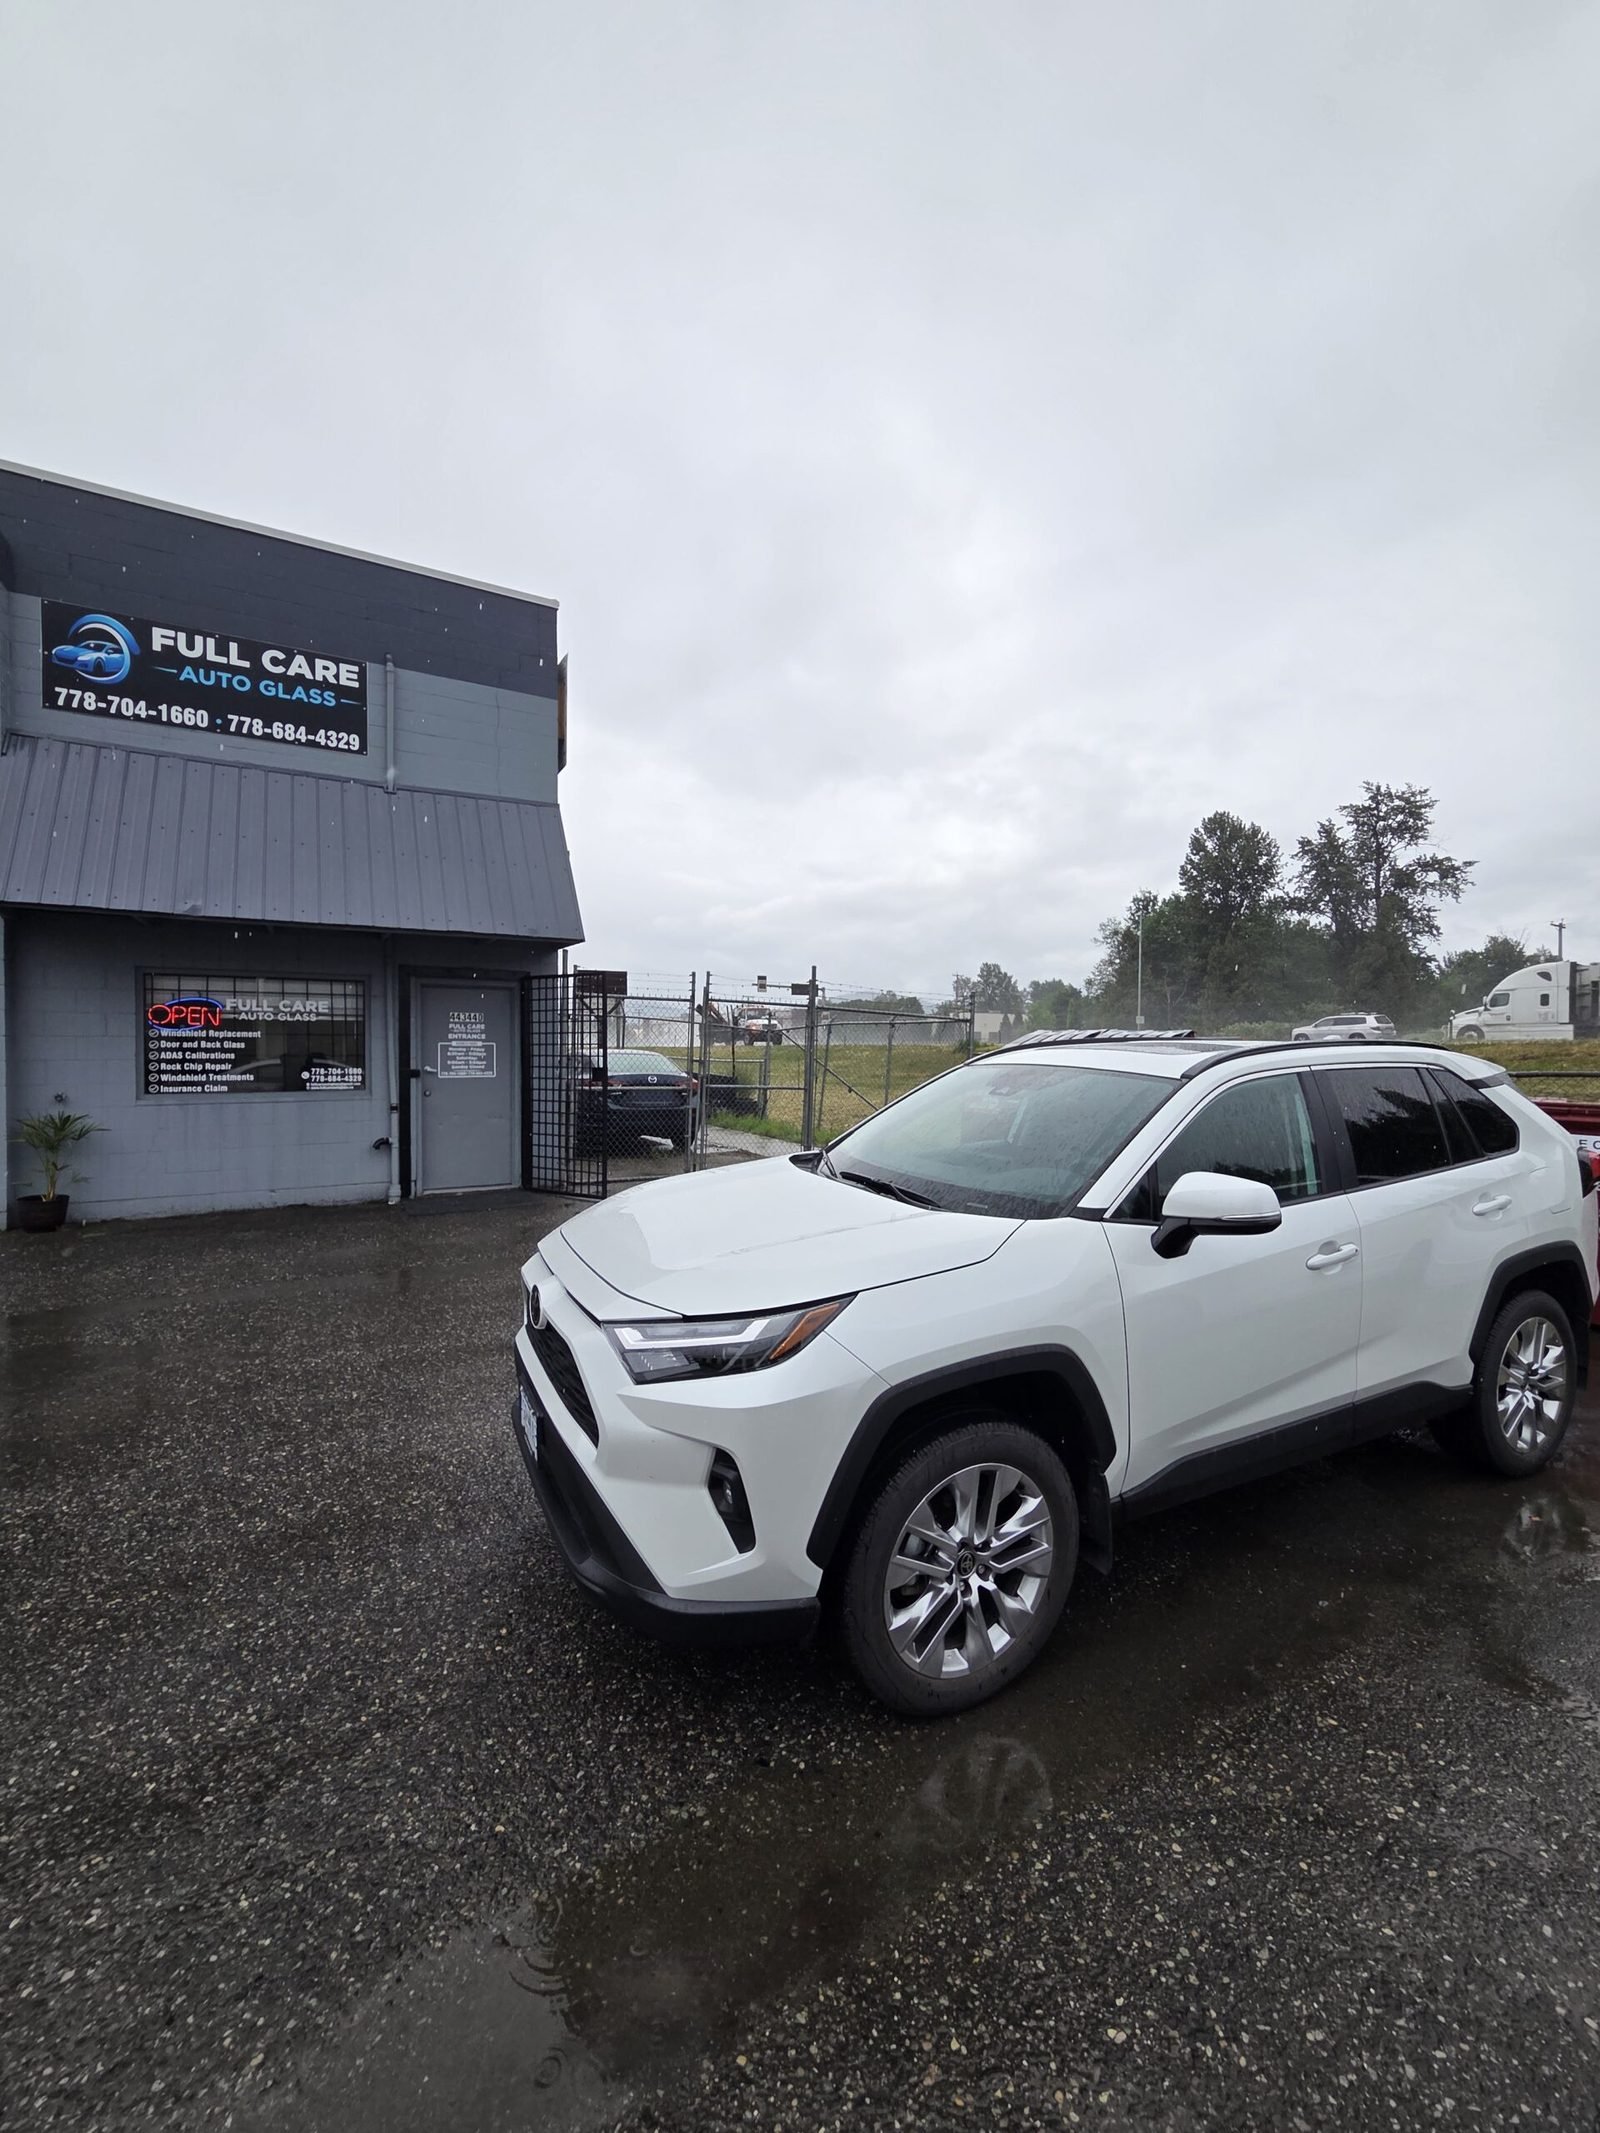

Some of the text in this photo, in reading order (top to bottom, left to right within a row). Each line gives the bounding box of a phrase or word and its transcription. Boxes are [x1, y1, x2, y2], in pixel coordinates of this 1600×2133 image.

[151, 626, 360, 688] FULL CARE
[178, 665, 336, 707] AUTO GLASS
[54, 686, 360, 751] 778-704-1660 778-684-4329
[225, 998, 329, 1013] FULL CARE
[148, 1004, 222, 1027] OPEN
[238, 1012, 317, 1022] AUTO GLASS
[160, 1029, 261, 1039] Windshield Replacement
[160, 1040, 245, 1049] Door and Back Glass
[160, 1051, 235, 1059] ADAS Calibrations
[184, 1063, 203, 1071] Chip
[205, 1063, 232, 1071] Repair
[160, 1073, 254, 1081] Windshield Treatments
[204, 1084, 228, 1092] Claim
